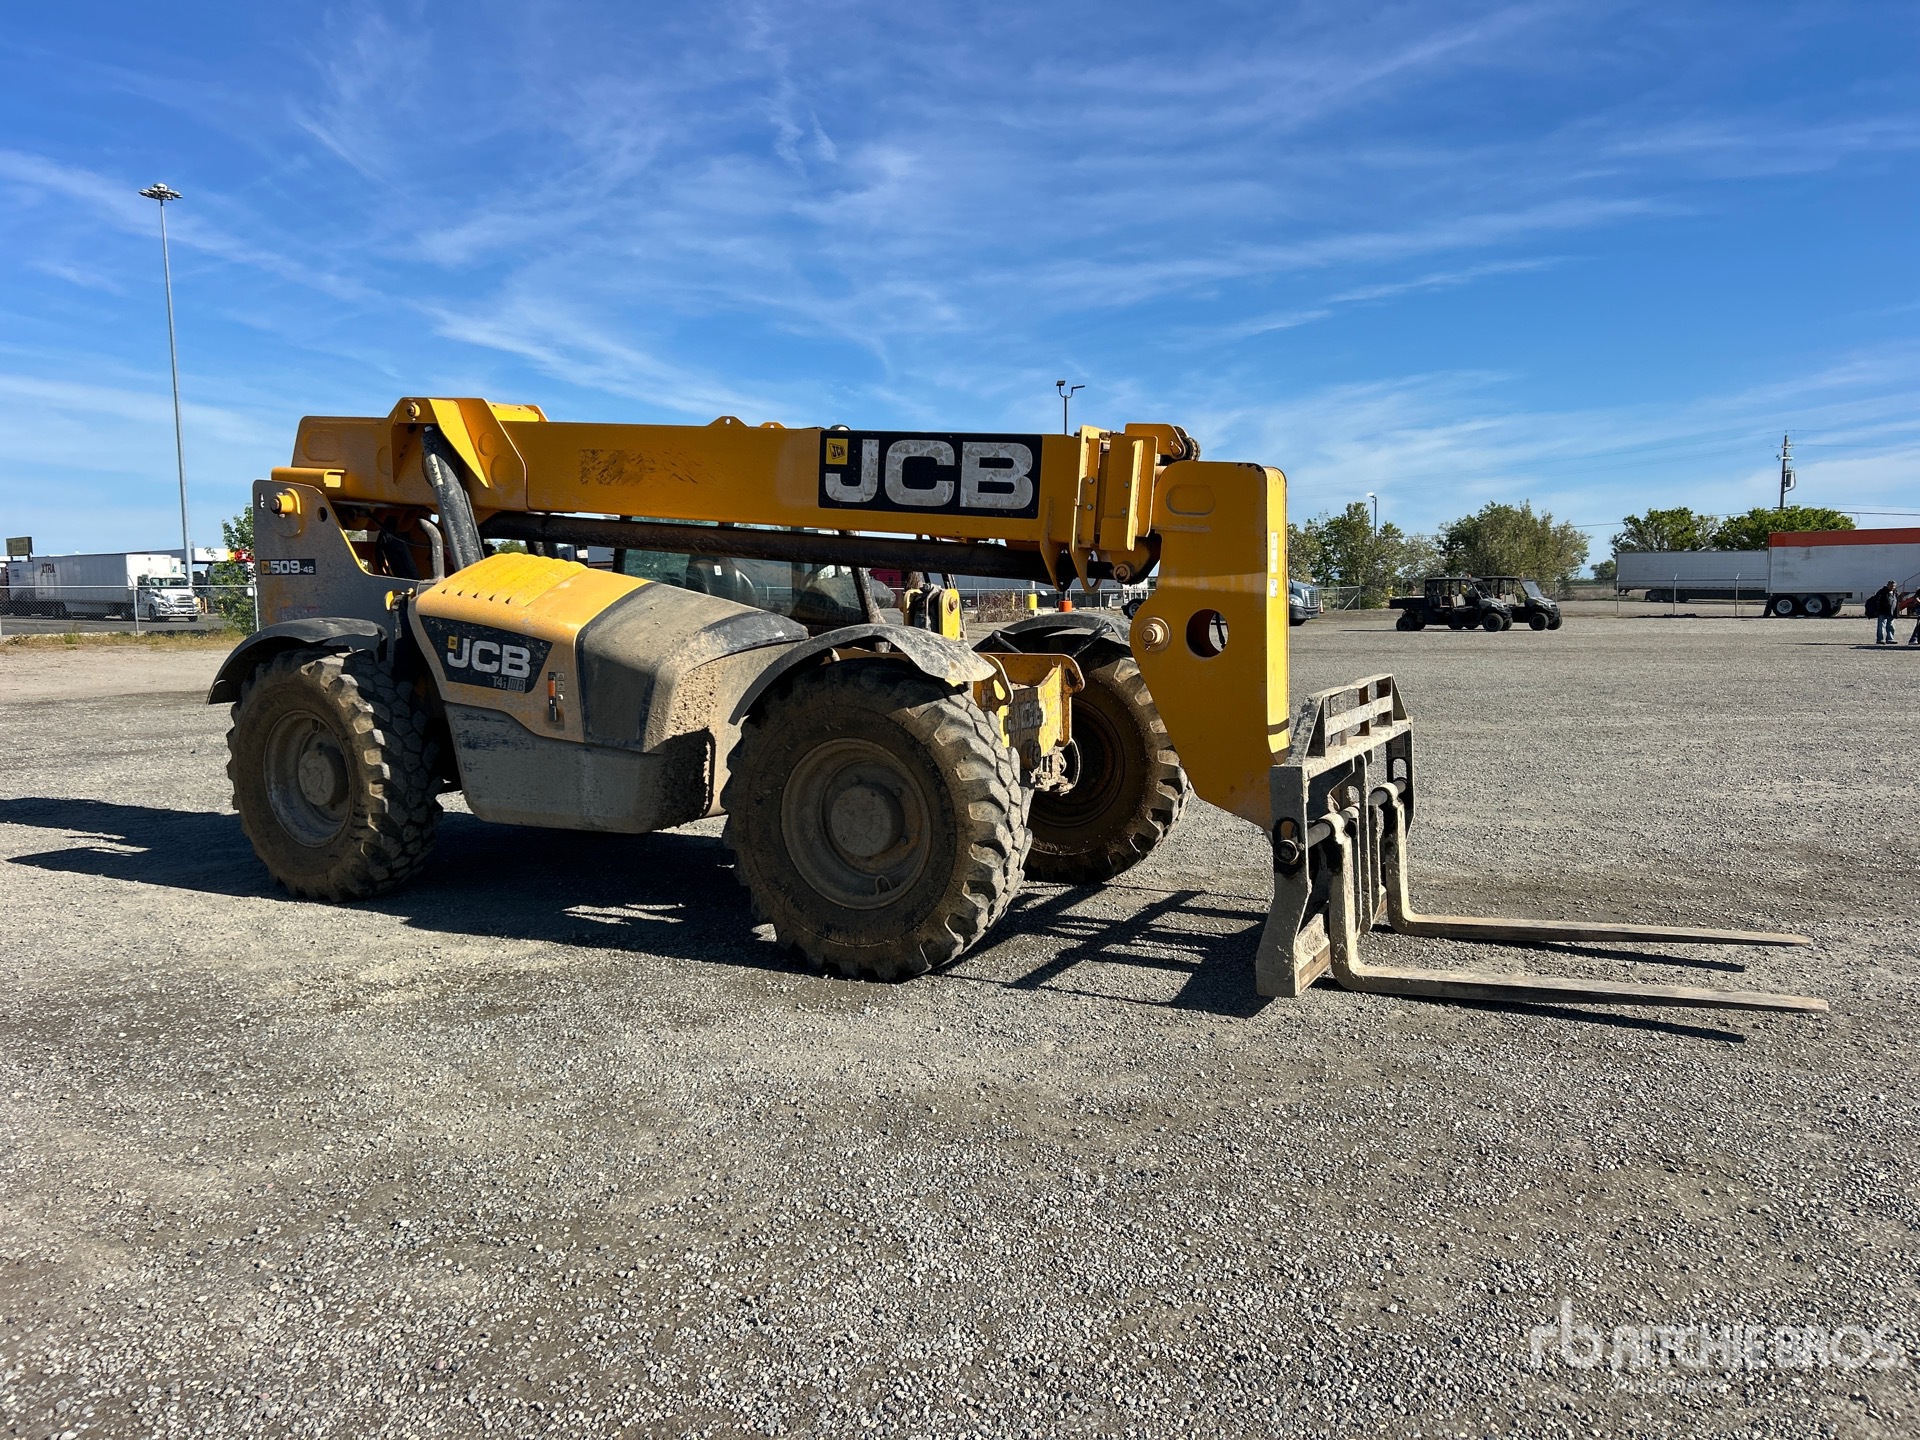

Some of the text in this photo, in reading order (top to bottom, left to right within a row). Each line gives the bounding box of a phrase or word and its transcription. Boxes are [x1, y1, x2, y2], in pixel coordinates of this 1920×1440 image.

[825, 438, 1034, 510] JCB
[446, 637, 531, 679] JCB
[491, 675, 507, 690] T4i
